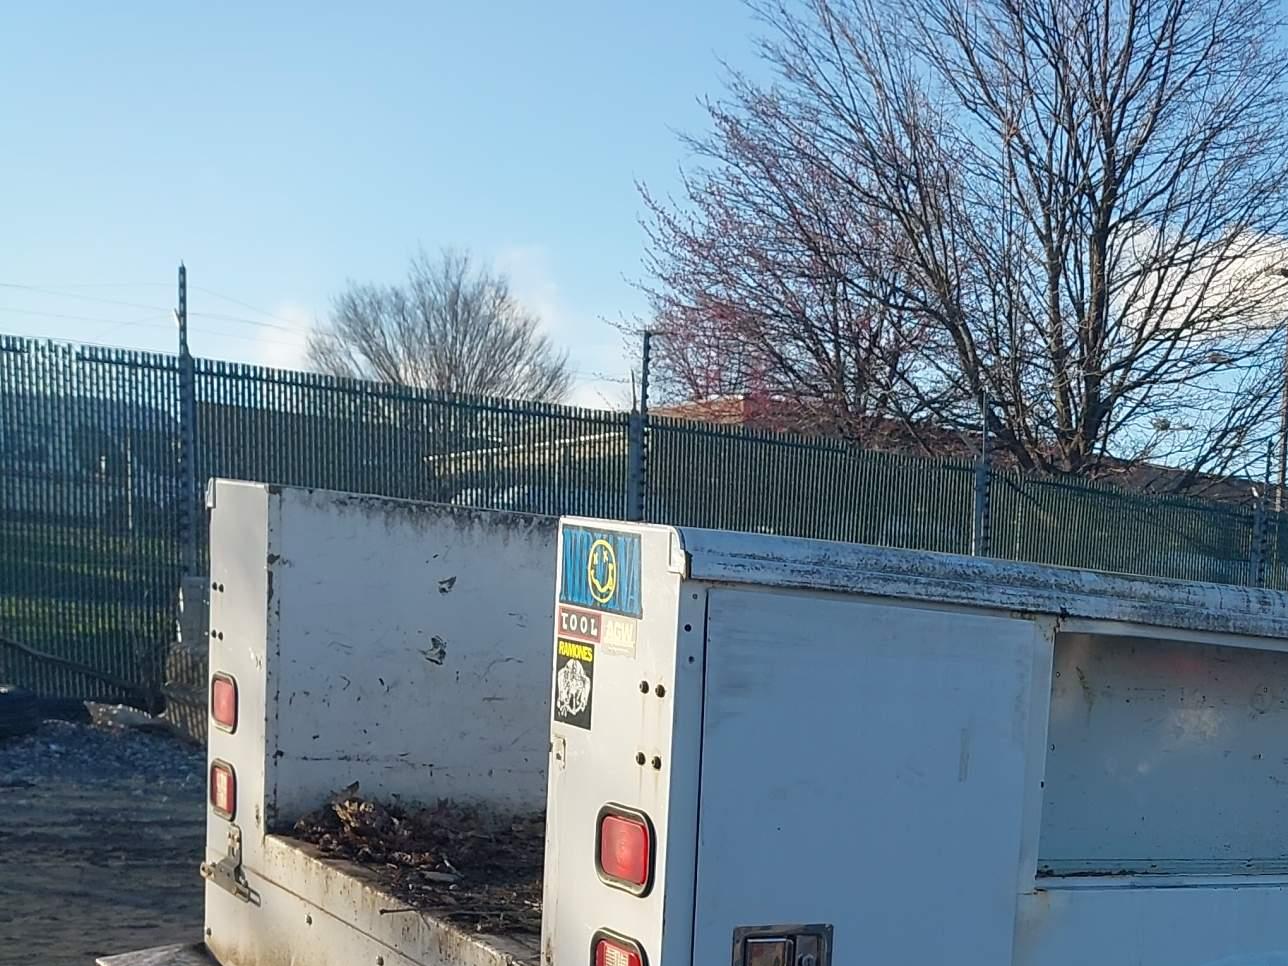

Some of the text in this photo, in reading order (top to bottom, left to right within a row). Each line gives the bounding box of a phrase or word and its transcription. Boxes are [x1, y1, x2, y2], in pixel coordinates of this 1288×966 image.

[561, 614, 598, 636] TOOL
[604, 621, 634, 642] AGW
[559, 641, 593, 662] RAMONES
